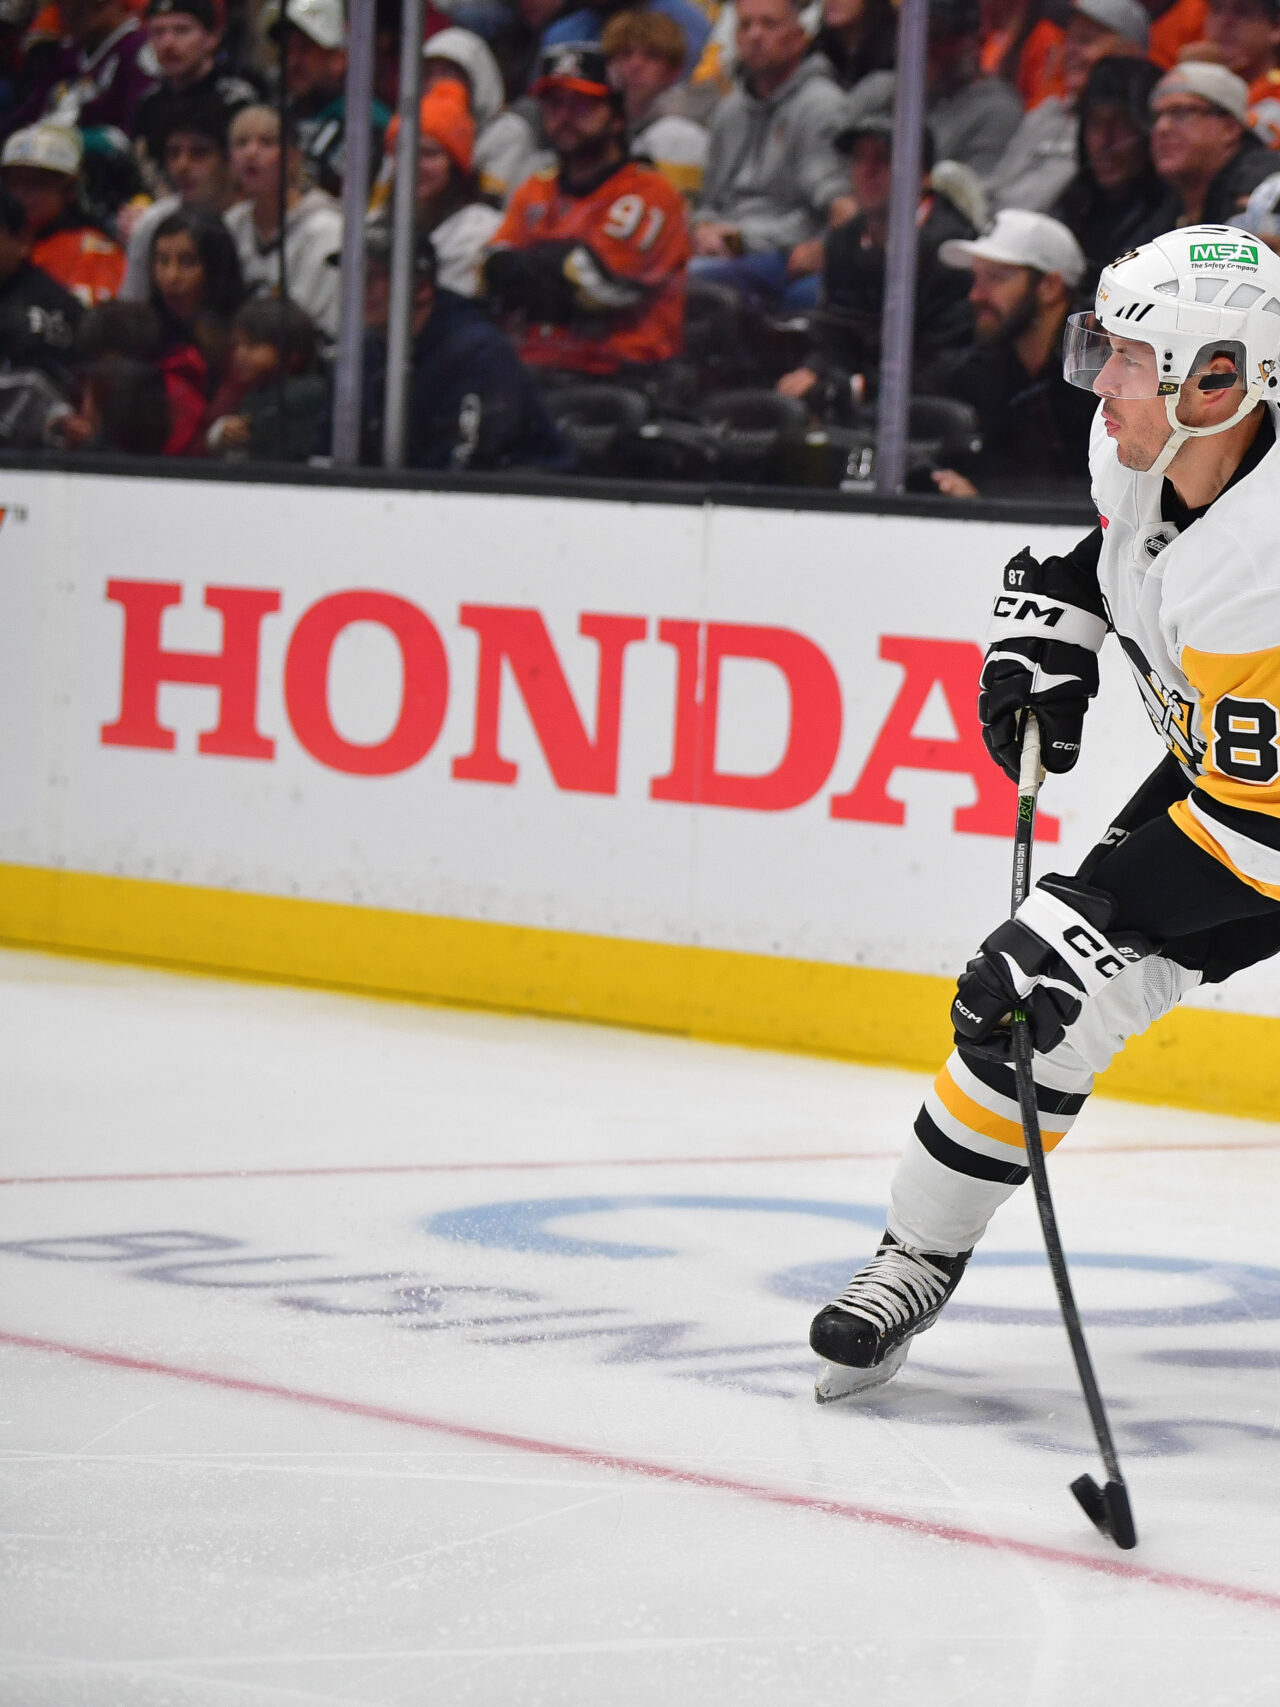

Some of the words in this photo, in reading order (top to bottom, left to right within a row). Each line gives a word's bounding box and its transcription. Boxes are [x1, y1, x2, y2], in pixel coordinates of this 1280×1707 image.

[604, 194, 665, 251] 91
[1193, 245, 1256, 263] MSA
[1008, 569, 1025, 586] 87
[993, 596, 1065, 627] CM
[100, 576, 1061, 844] HONDA
[1015, 843, 1026, 886] CROSBY
[1062, 925, 1126, 981] CC
[1117, 946, 1142, 960] 87
[955, 999, 983, 1024] CCM
